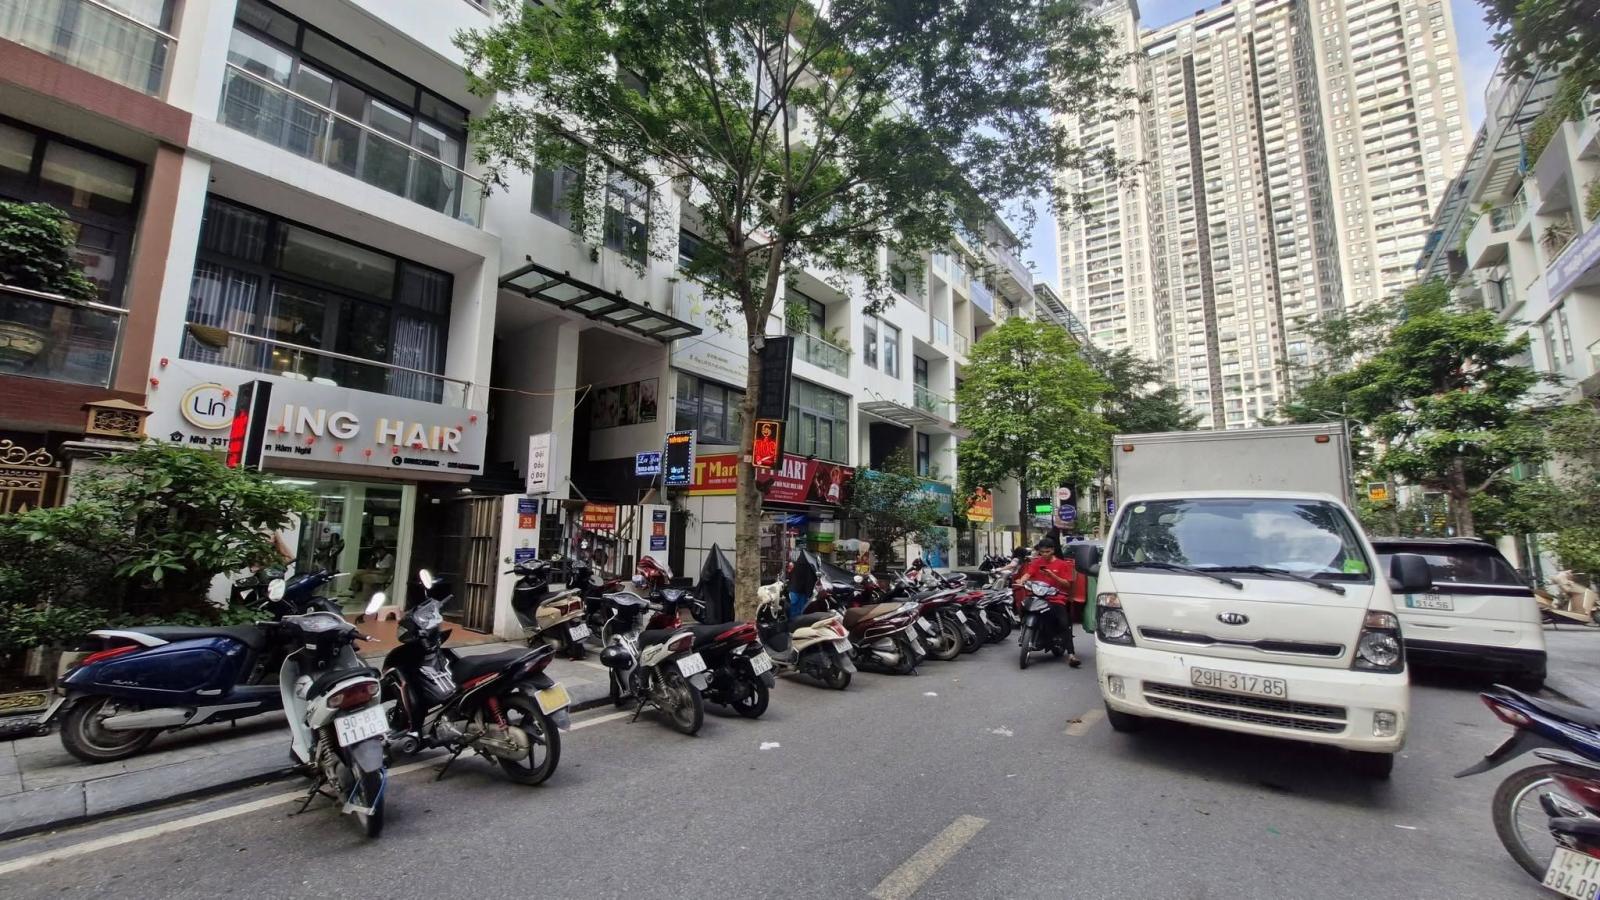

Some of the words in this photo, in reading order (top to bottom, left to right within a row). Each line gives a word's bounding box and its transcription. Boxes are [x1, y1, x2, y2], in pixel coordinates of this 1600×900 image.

[193, 396, 226, 417] Lin
[376, 418, 463, 453] HAIR
[1220, 612, 1247, 625] KIA
[1193, 669, 1284, 697] 29H-317.85
